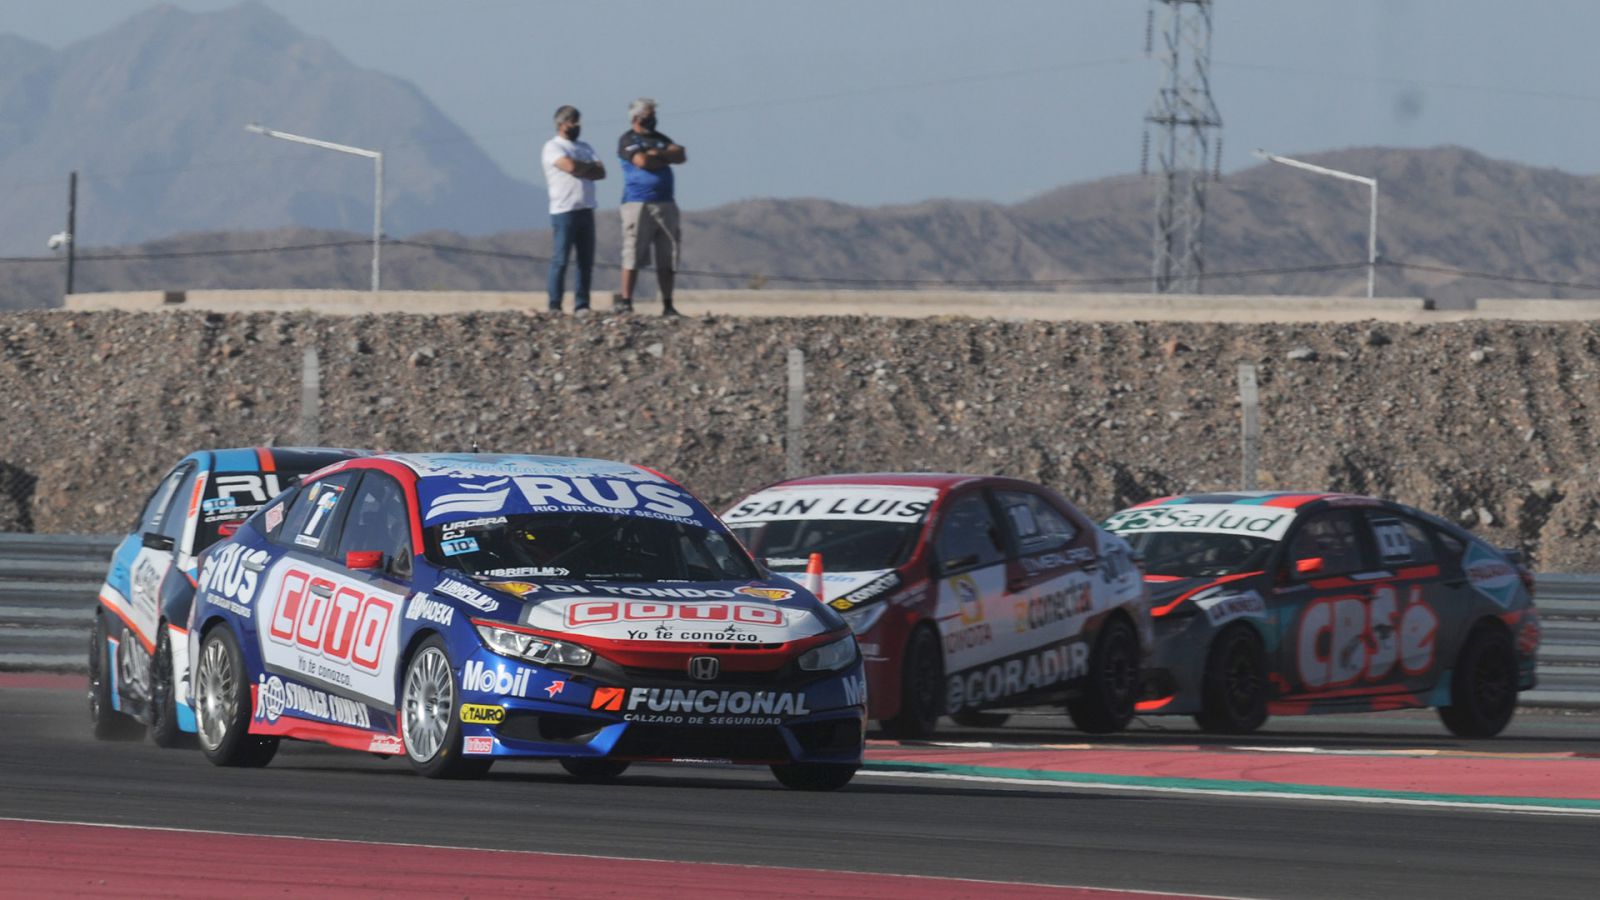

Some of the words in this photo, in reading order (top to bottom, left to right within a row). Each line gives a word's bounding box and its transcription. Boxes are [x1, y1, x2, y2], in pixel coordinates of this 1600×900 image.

[513, 476, 694, 517] RUS
[731, 498, 820, 518] SAN
[828, 498, 932, 517] LUIS
[533, 505, 559, 513] RIO
[562, 505, 632, 516] URUGUAY
[635, 509, 703, 527] SEGUROS
[442, 530, 466, 540] CJ
[210, 542, 272, 604] RUS
[434, 578, 489, 610] LUBRIFILM
[544, 584, 590, 594] DI
[603, 585, 735, 599] TONDO
[271, 568, 394, 671] COTO
[569, 602, 783, 626] COTO
[627, 629, 648, 640] Yo
[655, 629, 673, 641] te
[680, 630, 764, 643] conozco.
[463, 660, 531, 697] Mobil
[627, 687, 810, 715] FUNCIONAL
[469, 707, 504, 721] TAURO
[624, 713, 683, 724] CALZADO
[688, 716, 703, 725] DE
[709, 716, 782, 725] SEGURIDAD
